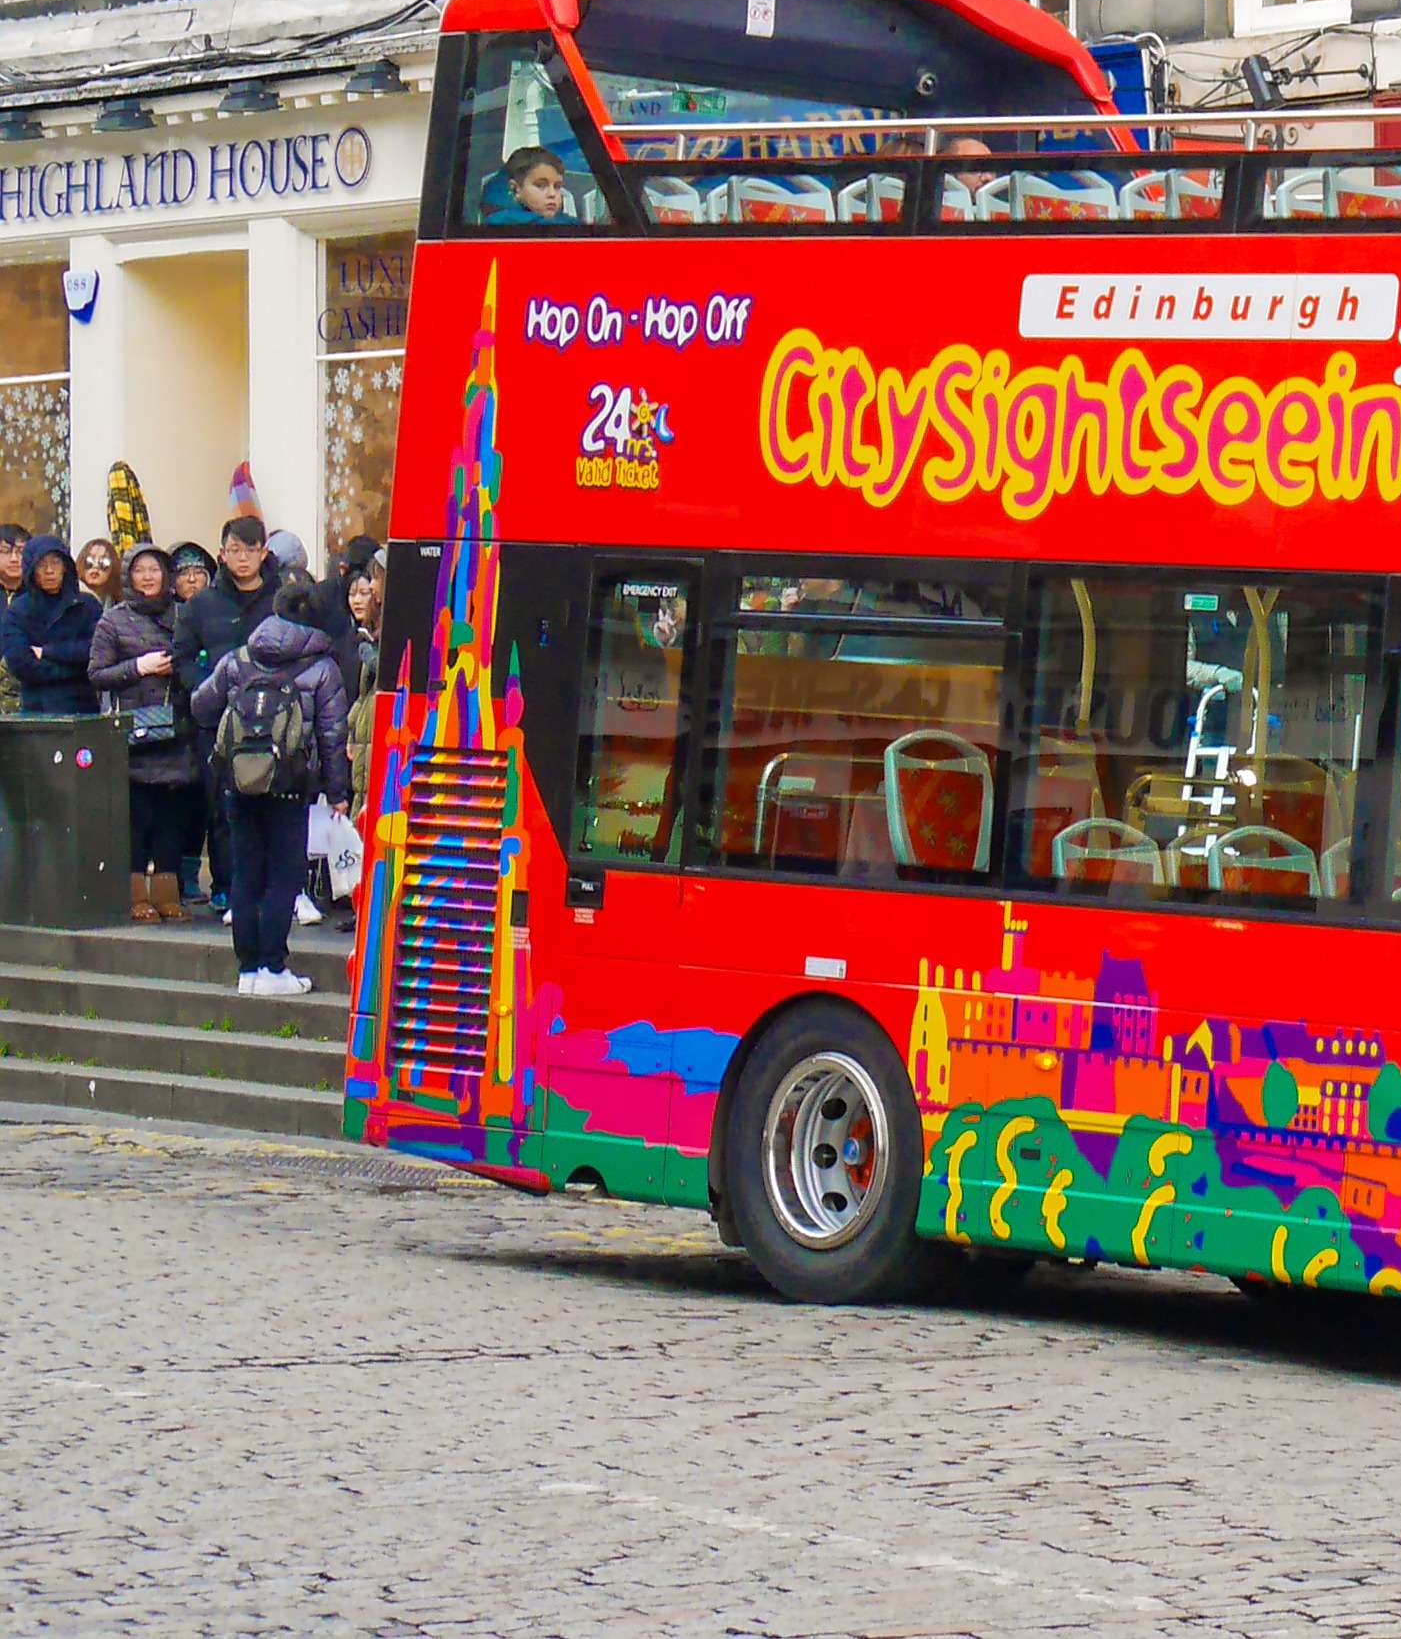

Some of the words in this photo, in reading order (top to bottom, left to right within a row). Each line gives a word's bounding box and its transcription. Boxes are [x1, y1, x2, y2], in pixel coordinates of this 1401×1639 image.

[740, 108, 905, 160] HARRI
[0, 147, 198, 224] HIGHLAND
[207, 133, 331, 202] HOUSE
[526, 299, 579, 347] Hop
[586, 296, 622, 342] On
[645, 297, 698, 347] Hop
[705, 294, 751, 341] Off
[1055, 283, 1361, 329] Edinburgh
[582, 383, 632, 454] 24
[576, 456, 613, 488] Valid
[615, 456, 660, 490] Ticket
[419, 545, 441, 558] WATER
[622, 582, 662, 597] EMERGENCY
